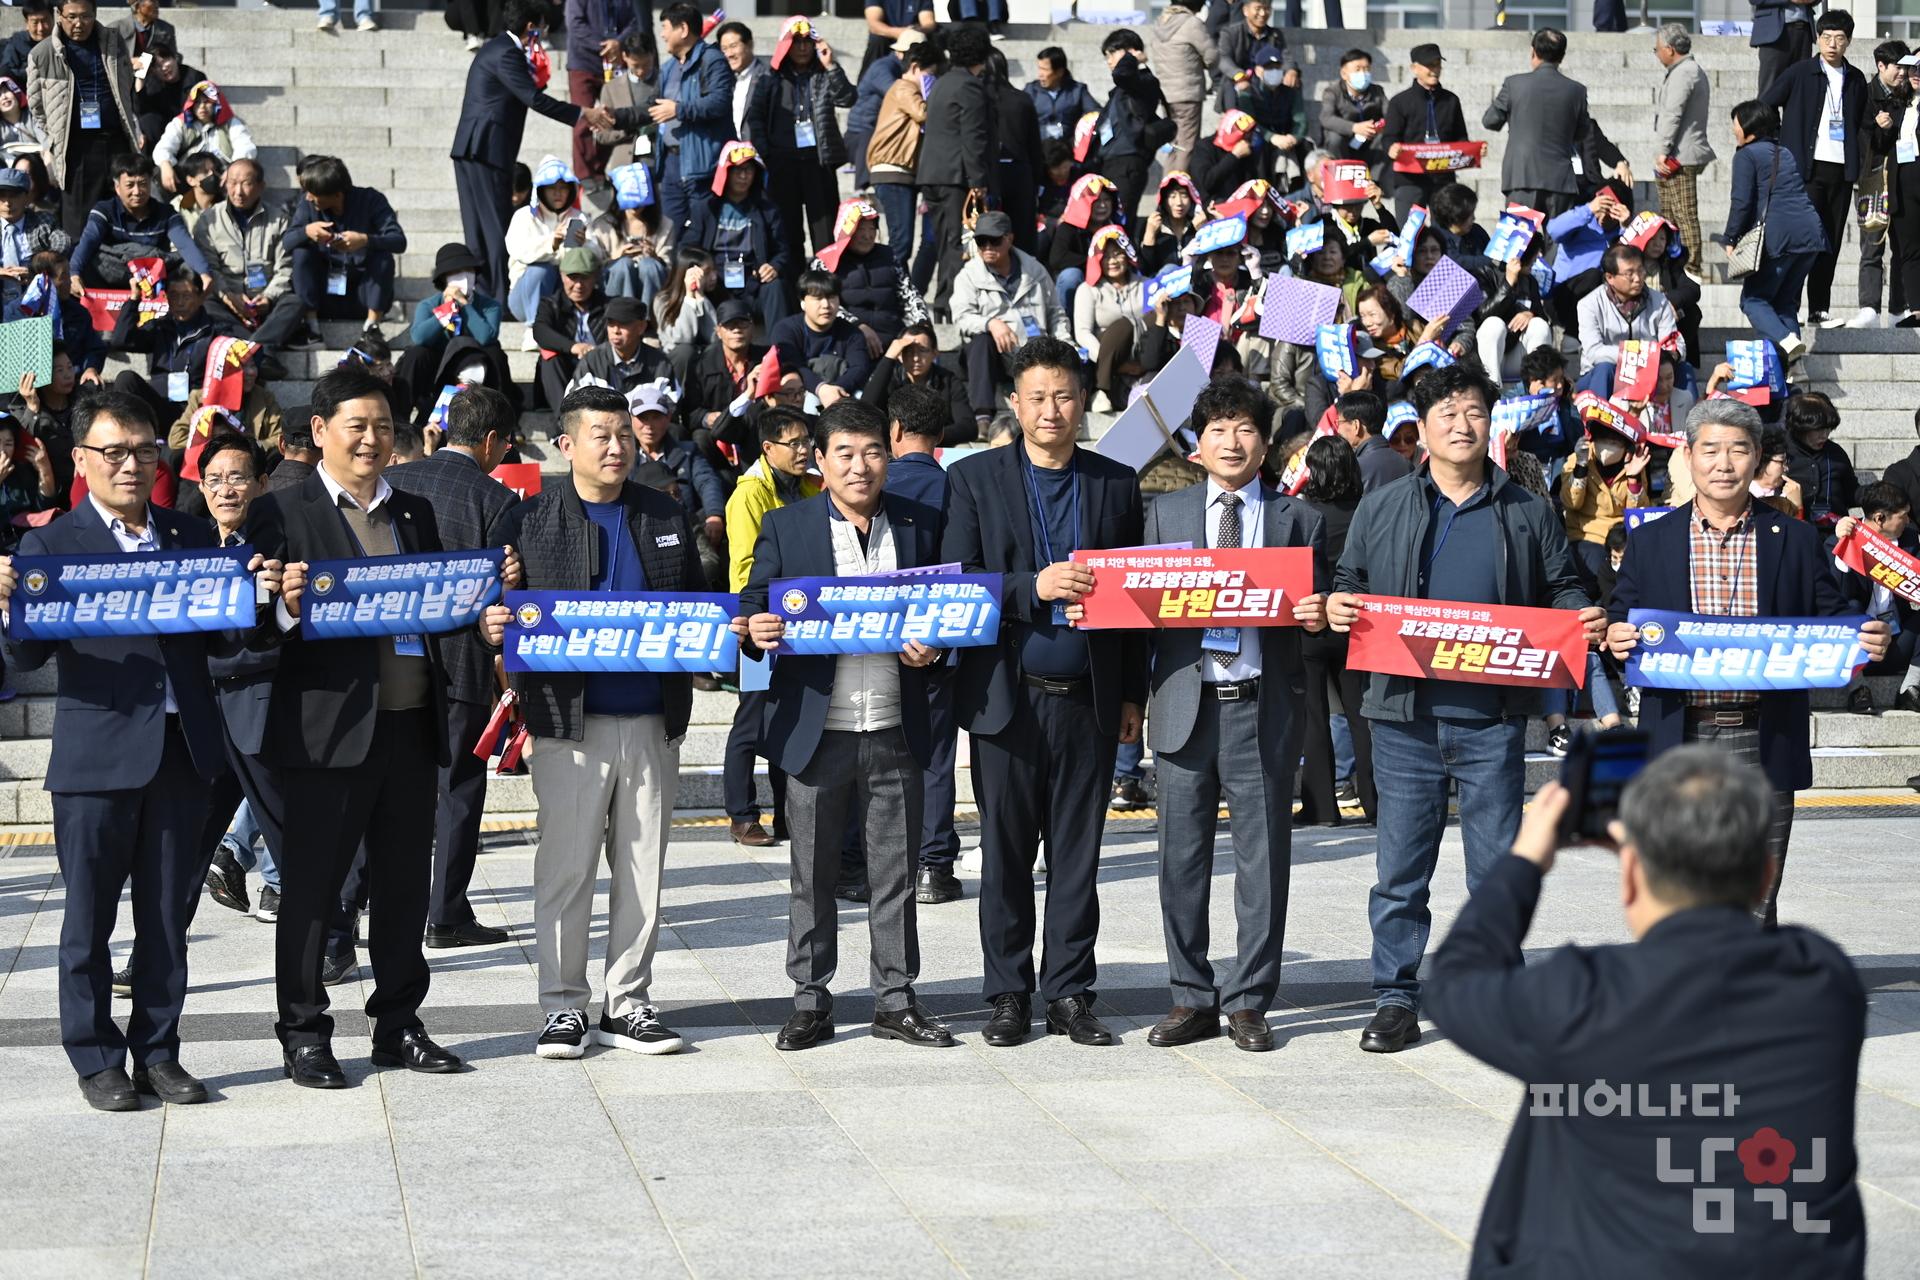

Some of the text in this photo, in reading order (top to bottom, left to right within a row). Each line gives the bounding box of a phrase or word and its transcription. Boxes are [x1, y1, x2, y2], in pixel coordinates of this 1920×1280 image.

[59, 557, 238, 581] 제2중앙경찰학교 최적지는
[343, 557, 494, 583] 제2중앙경찰학교 최적지는
[1087, 556, 1215, 568] 미래 치안 핵심인재 양성의 요람,
[817, 583, 986, 601] 제2중앙경찰학교 최적지는
[1122, 570, 1246, 588] 제2중앙경찰학교
[24, 576, 243, 623] 남원! 남원! 남원!
[310, 576, 495, 622] 남원! 남원! 남원!
[551, 600, 723, 618] 제2중앙경찰학교 최적지는
[1158, 588, 1284, 618] 남원으로!
[782, 602, 992, 639] 남원! 남원! 남원!
[1364, 602, 1493, 623] 미래 치안 핵심인재 양성의 요람,
[516, 621, 728, 660] 남원! 남원! 남원!
[1206, 629, 1222, 639] 743
[1397, 619, 1523, 646] 제2중앙경찰학교
[1675, 621, 1857, 640] 제2중앙경찰학교 최적지는
[1430, 640, 1560, 680] 남원으로!
[1639, 642, 1861, 678] 남원! 남원! 남원!
